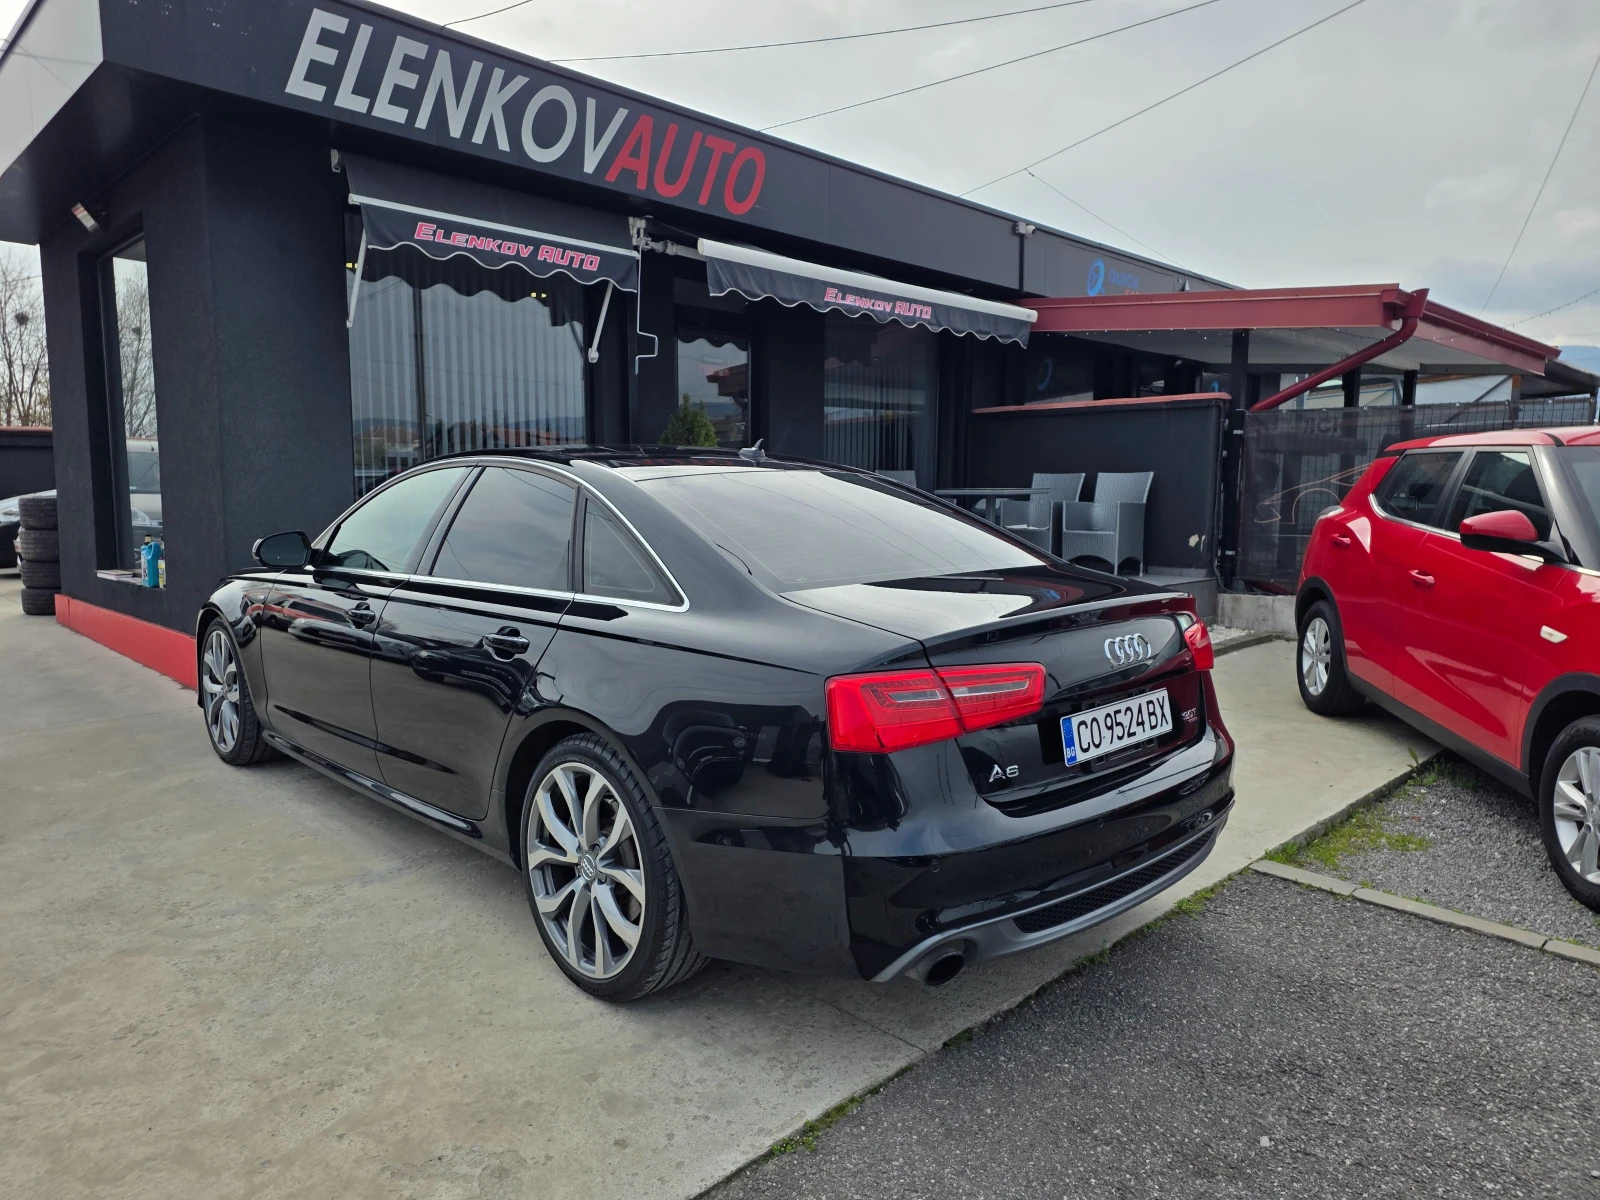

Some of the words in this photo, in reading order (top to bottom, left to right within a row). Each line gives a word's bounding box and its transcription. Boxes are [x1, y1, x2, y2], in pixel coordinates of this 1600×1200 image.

[538, 245, 600, 271] AUTO
[895, 301, 931, 319] AUTO
[1066, 746, 1075, 758] BG
[988, 764, 1019, 783] A6
